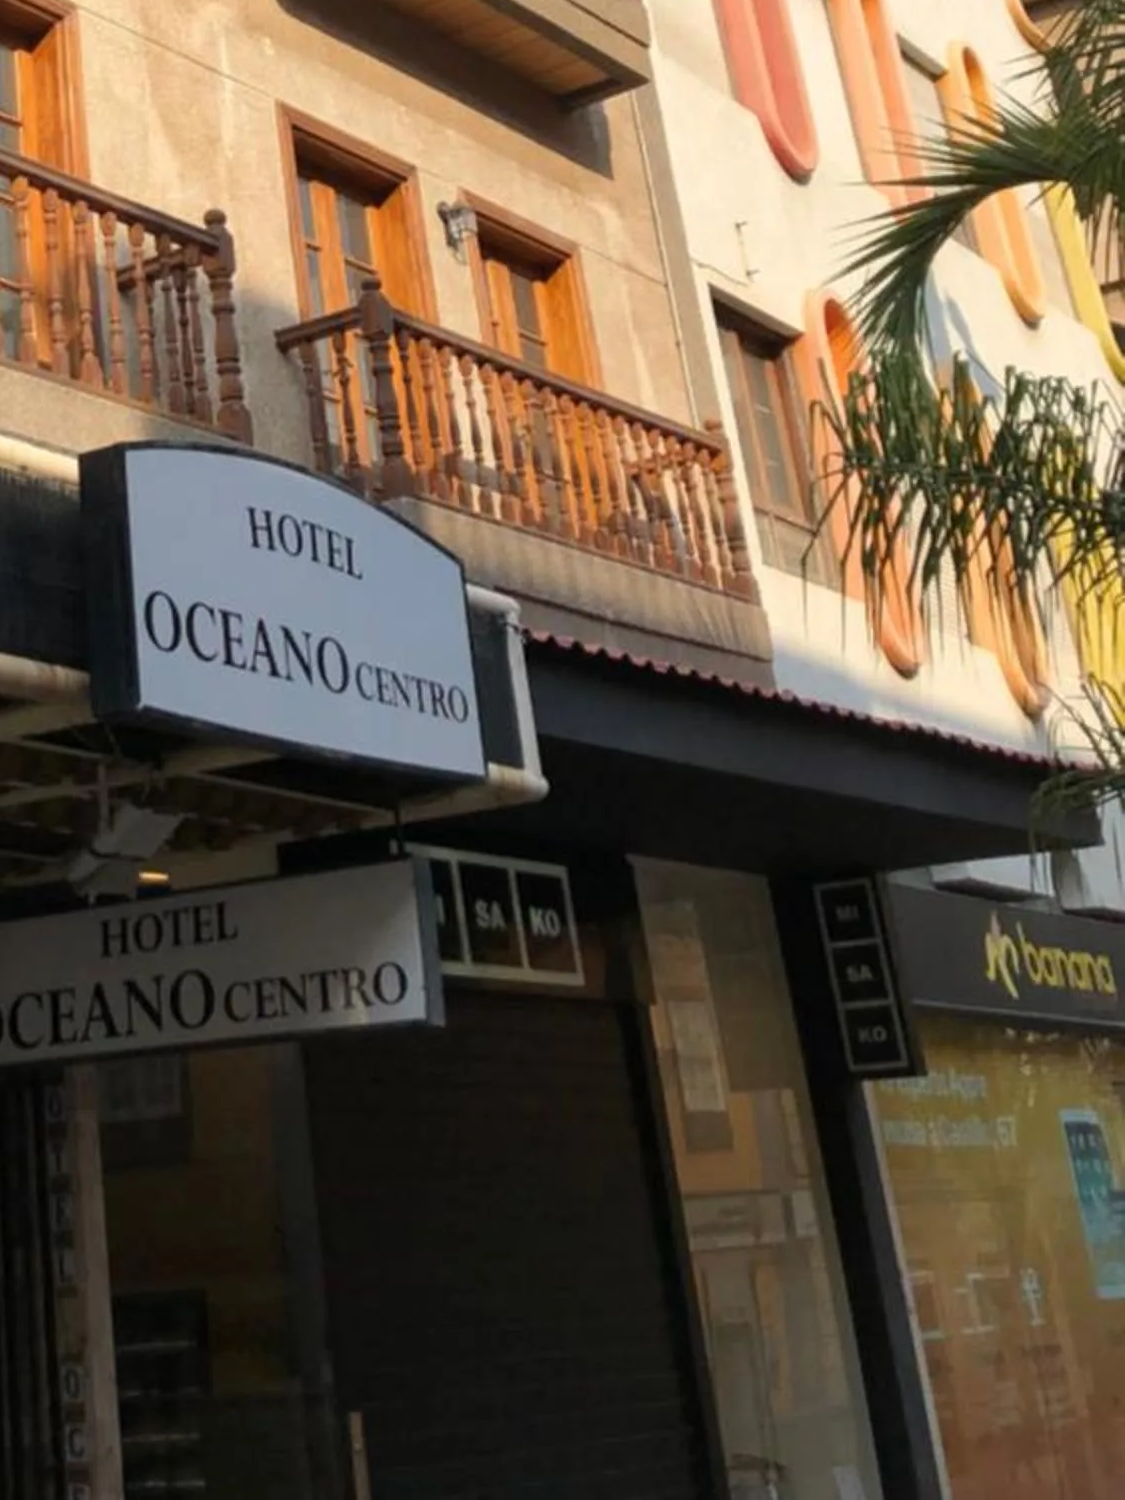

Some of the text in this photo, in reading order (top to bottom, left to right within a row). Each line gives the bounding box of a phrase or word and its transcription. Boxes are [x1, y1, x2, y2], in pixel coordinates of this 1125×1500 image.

[246, 506, 363, 580] HOTEL
[144, 591, 469, 724] OCEANO CENTRO
[100, 901, 237, 958] HOTEL
[1015, 920, 1118, 995] banana
[223, 962, 408, 1024] CENTRO
[845, 964, 874, 982] SA
[857, 1025, 888, 1043] KO
